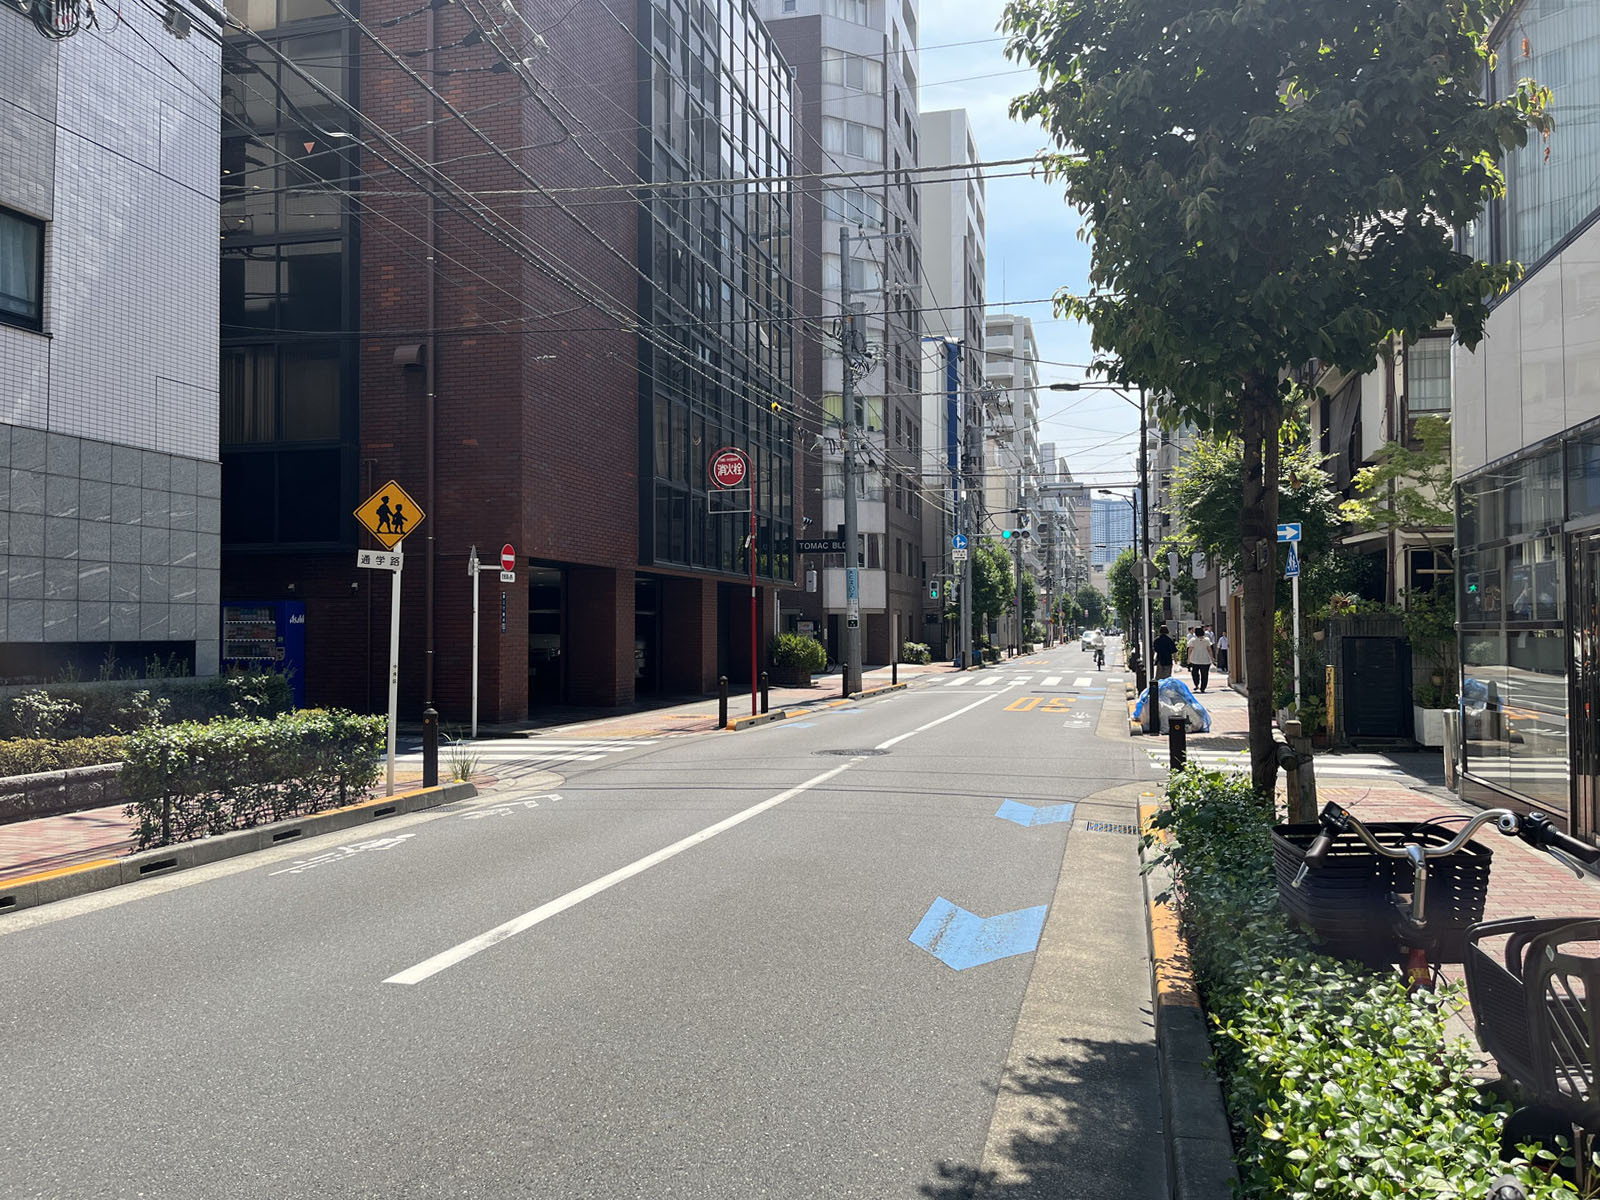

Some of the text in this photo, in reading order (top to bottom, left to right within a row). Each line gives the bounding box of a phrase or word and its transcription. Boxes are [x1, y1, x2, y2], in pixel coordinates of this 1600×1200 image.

[717, 462, 743, 477] 消火栓
[799, 542, 829, 550] TOMAC
[361, 554, 400, 566] 通学路
[1003, 696, 1077, 712] 30
